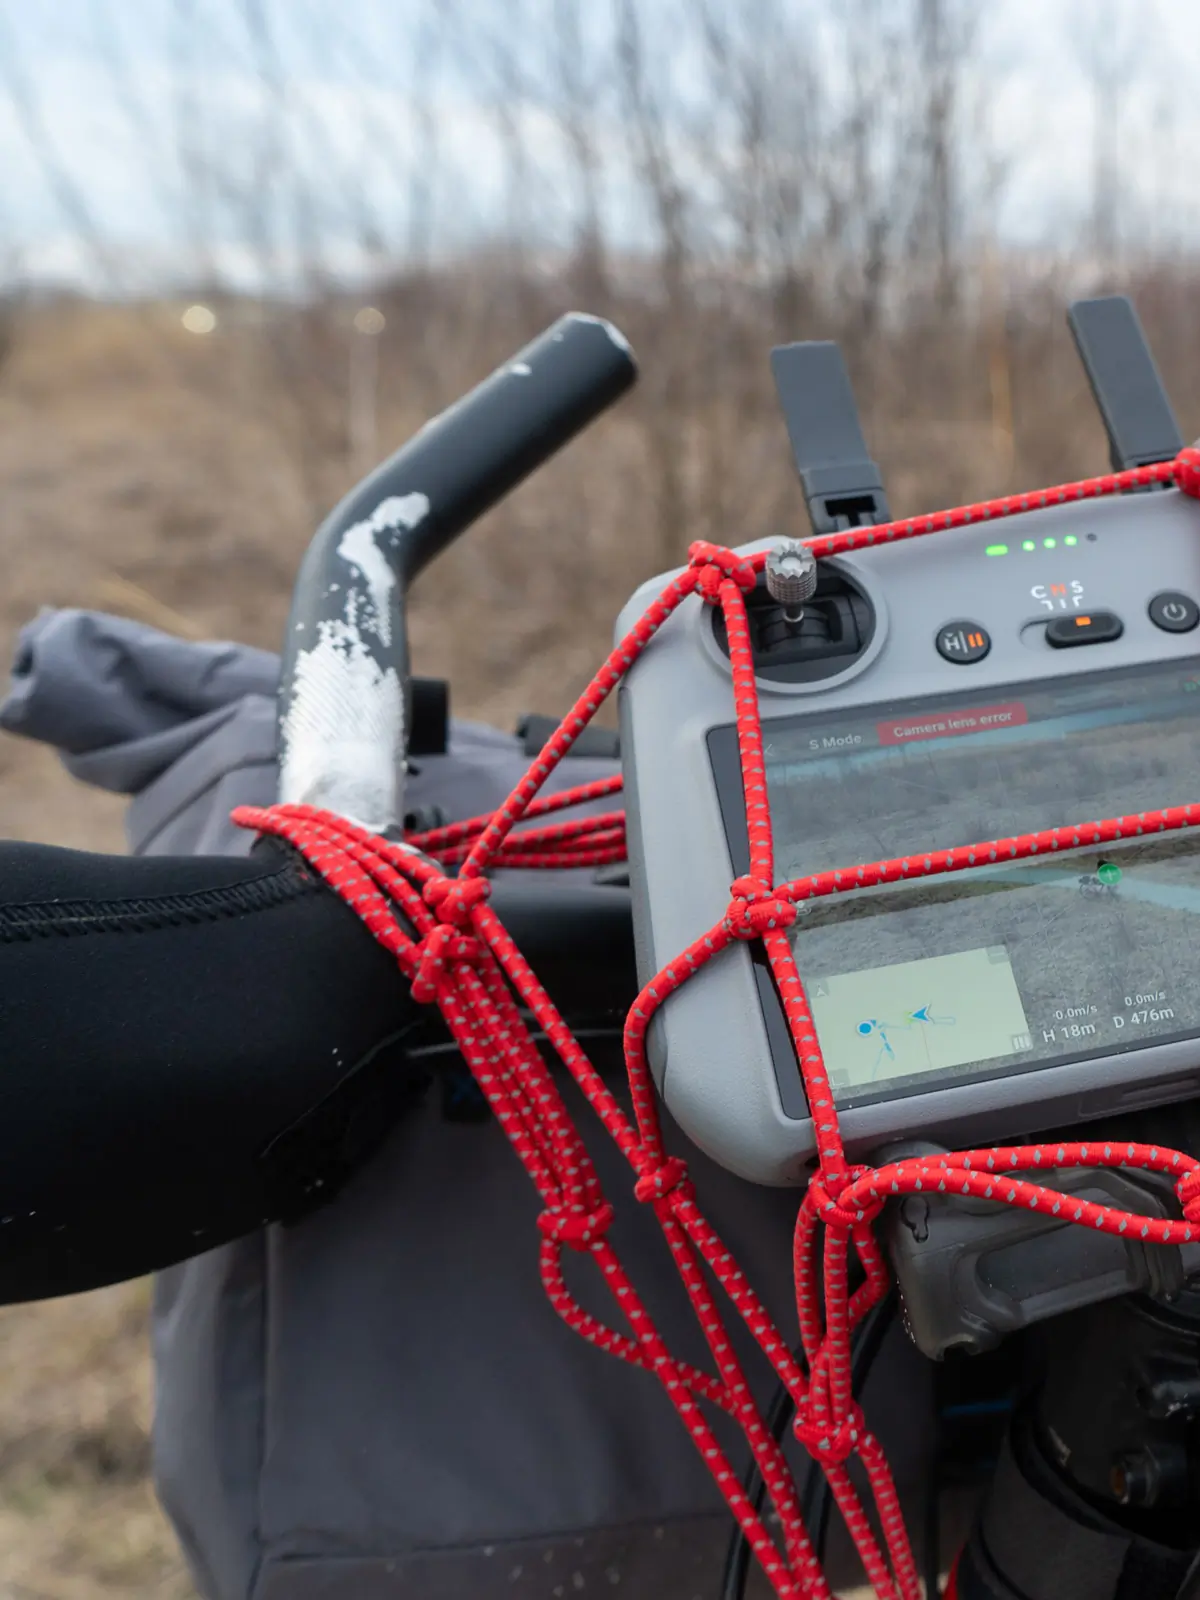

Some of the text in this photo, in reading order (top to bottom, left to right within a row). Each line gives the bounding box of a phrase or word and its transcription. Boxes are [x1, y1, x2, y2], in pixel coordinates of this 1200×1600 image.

[893, 711, 1013, 738] Camera lens error
[809, 733, 862, 750] S Mode
[1124, 991, 1166, 1006] 0.0m/s
[1113, 1007, 1175, 1028] D 476m
[1043, 1023, 1096, 1042] H 18m
